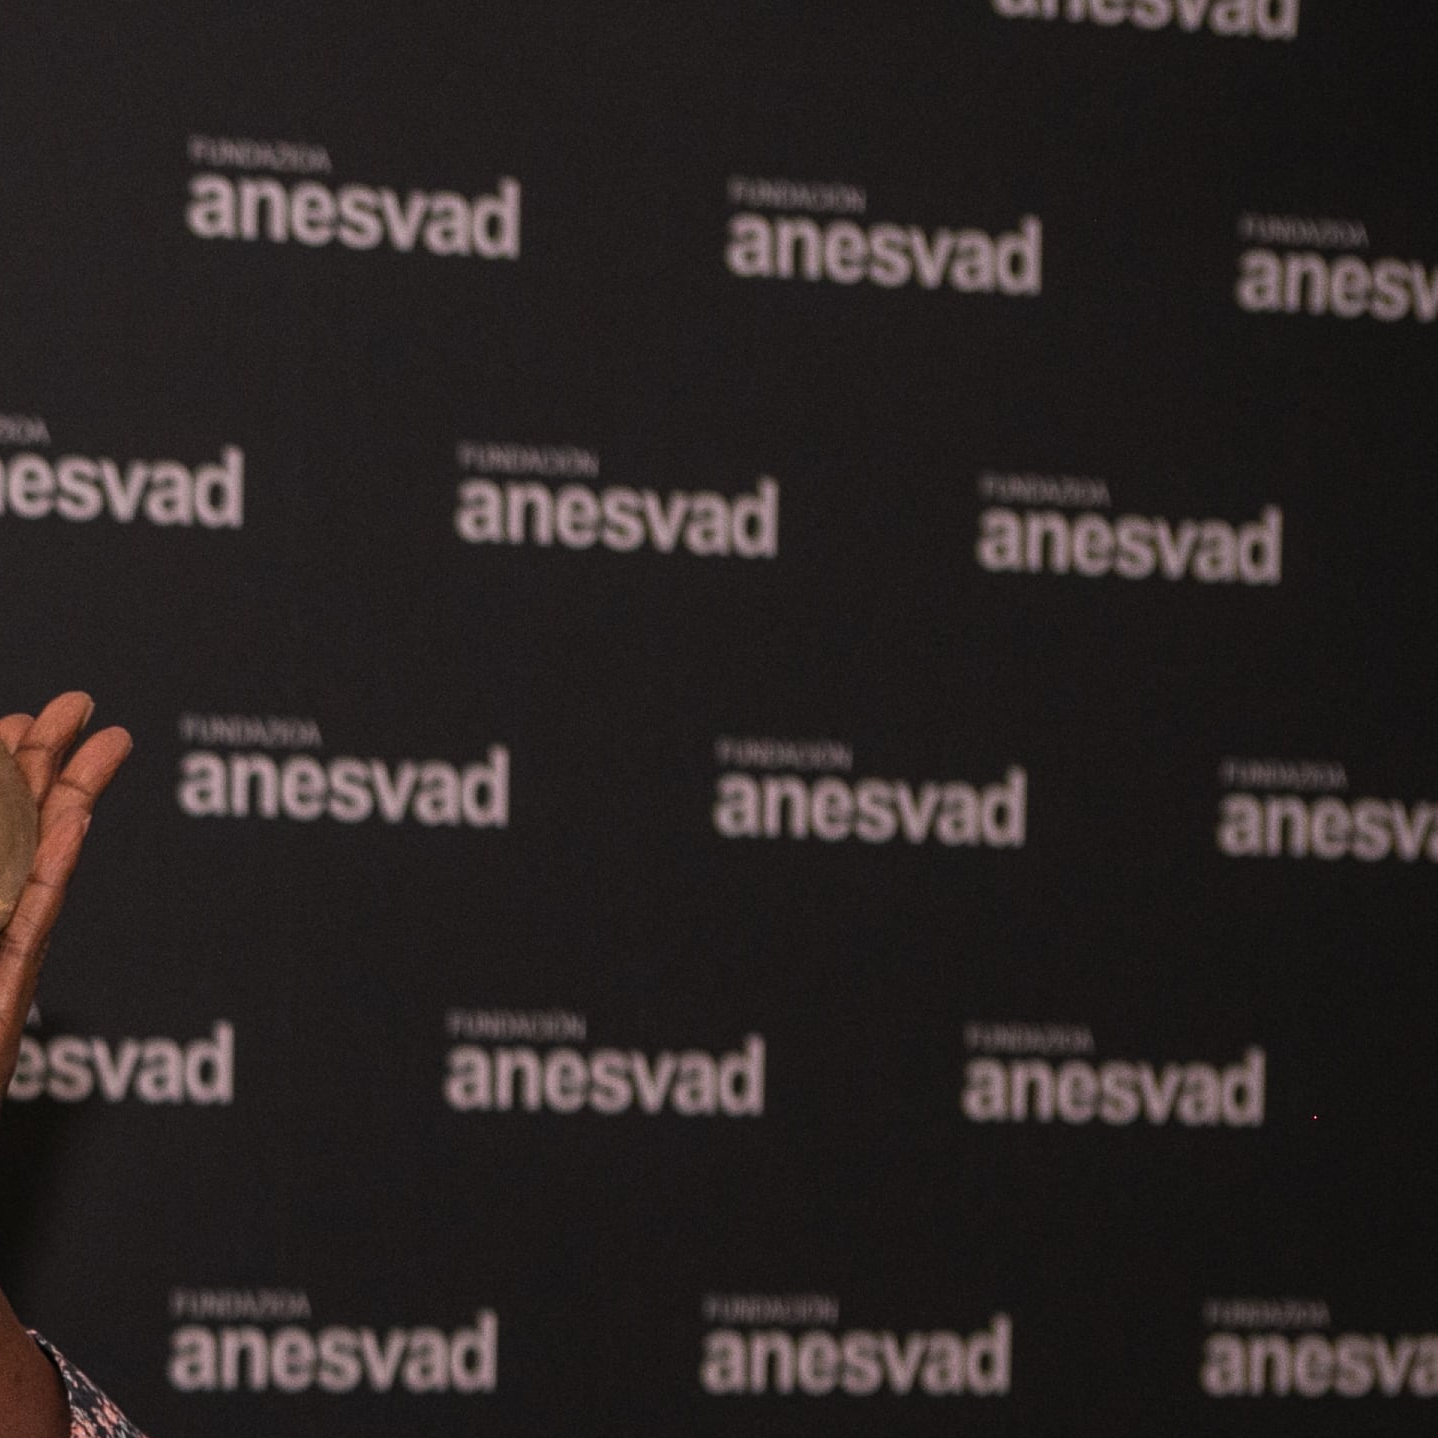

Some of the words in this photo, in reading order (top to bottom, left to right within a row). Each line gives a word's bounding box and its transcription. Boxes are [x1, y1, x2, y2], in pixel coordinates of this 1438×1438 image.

[188, 173, 520, 259] anesvad
[728, 214, 1041, 295] anesvad
[1239, 248, 1438, 321] anesv
[456, 477, 778, 557] anesvad
[979, 507, 1281, 583] anesvad
[179, 746, 509, 827] anesvad
[715, 767, 1026, 846] anesvad
[7, 1018, 235, 1104] esvad
[446, 1036, 764, 1115] anesvad
[964, 1049, 1264, 1125] anesvad
[170, 1311, 497, 1392] anesvad
[702, 1316, 1010, 1394] anesvad
[1204, 1334, 1438, 1396] anesva
